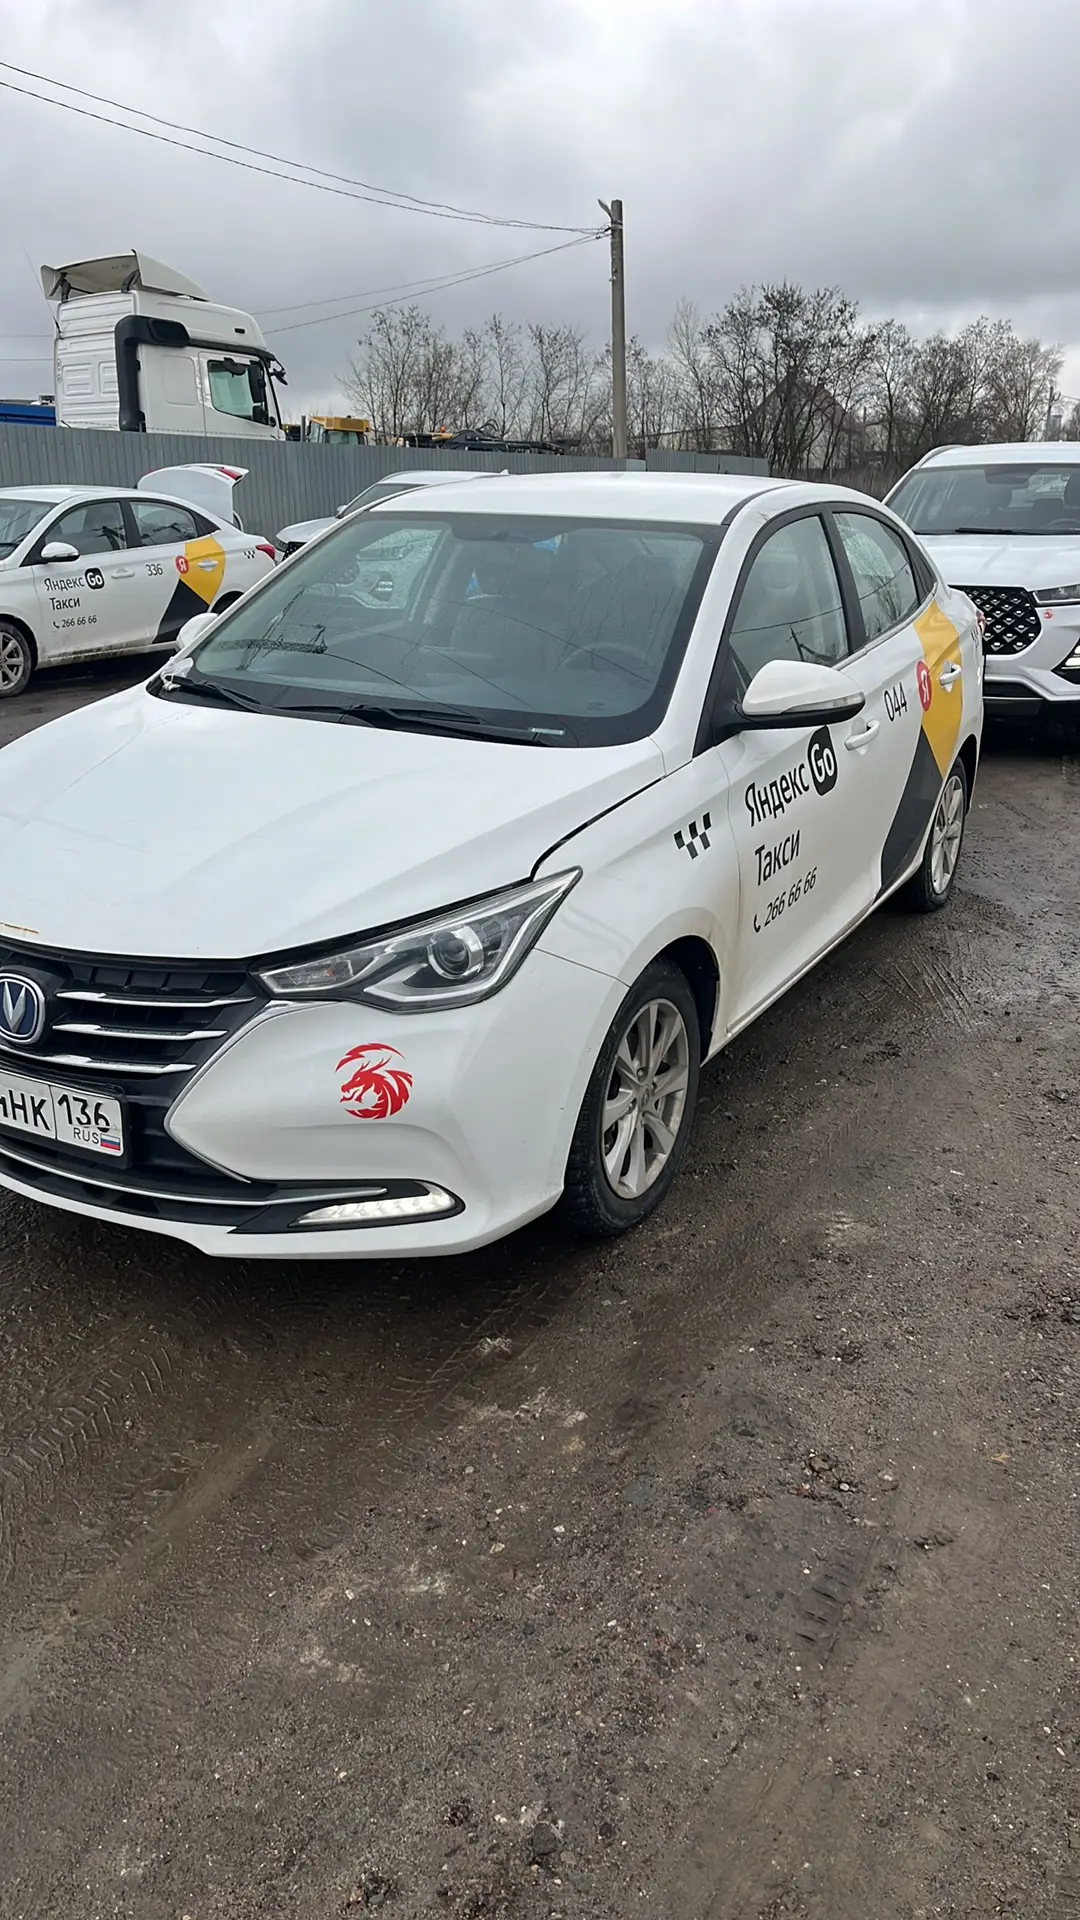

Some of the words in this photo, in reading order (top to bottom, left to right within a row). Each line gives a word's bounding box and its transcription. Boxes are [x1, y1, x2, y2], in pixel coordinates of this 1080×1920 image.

[145, 563, 163, 576] 336
[179, 557, 187, 571] Я
[44, 577, 85, 591] Яндекс
[86, 571, 103, 587] Go
[50, 596, 81, 611] Такси
[61, 618, 75, 628] 266
[76, 616, 86, 626] 66
[87, 614, 98, 624] 66
[920, 669, 930, 703] Я
[883, 681, 908, 722] 044
[745, 763, 810, 827] Яндекс
[811, 743, 835, 783] Go
[754, 830, 801, 887] Такси
[764, 891, 786, 927] 266
[787, 878, 801, 908] 66
[803, 866, 818, 895] 66
[57, 1093, 110, 1133] 136
[73, 1127, 100, 1145] RUS
